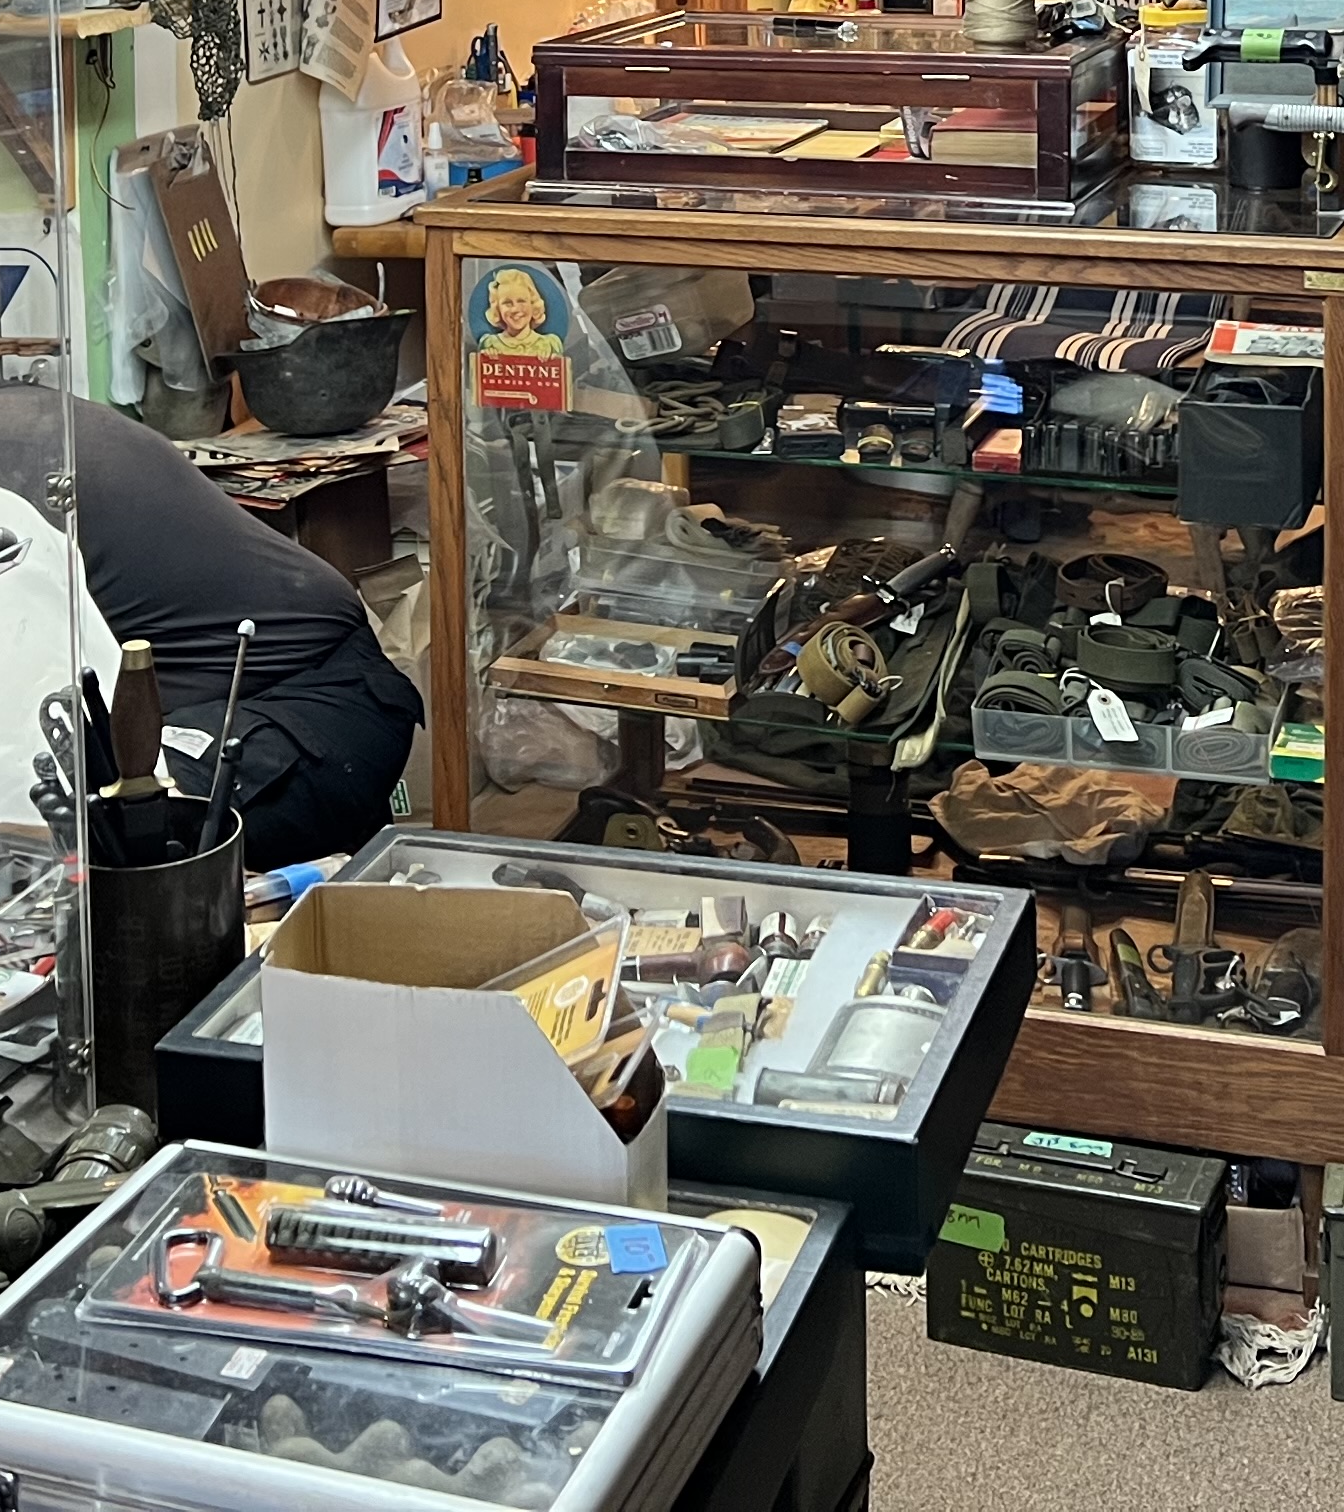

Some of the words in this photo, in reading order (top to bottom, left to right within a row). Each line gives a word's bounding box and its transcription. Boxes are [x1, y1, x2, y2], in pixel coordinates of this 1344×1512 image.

[482, 362, 561, 379] DENTYNE
[1020, 1241, 1103, 1270] CARTRIDGES
[1108, 1274, 1136, 1292] M13
[1001, 1287, 1029, 1306] M62
[960, 1293, 994, 1313] FUNC
[1003, 1304, 1026, 1319] LOT
[1035, 1309, 1052, 1325] RA
[1126, 1346, 1159, 1365] A131
